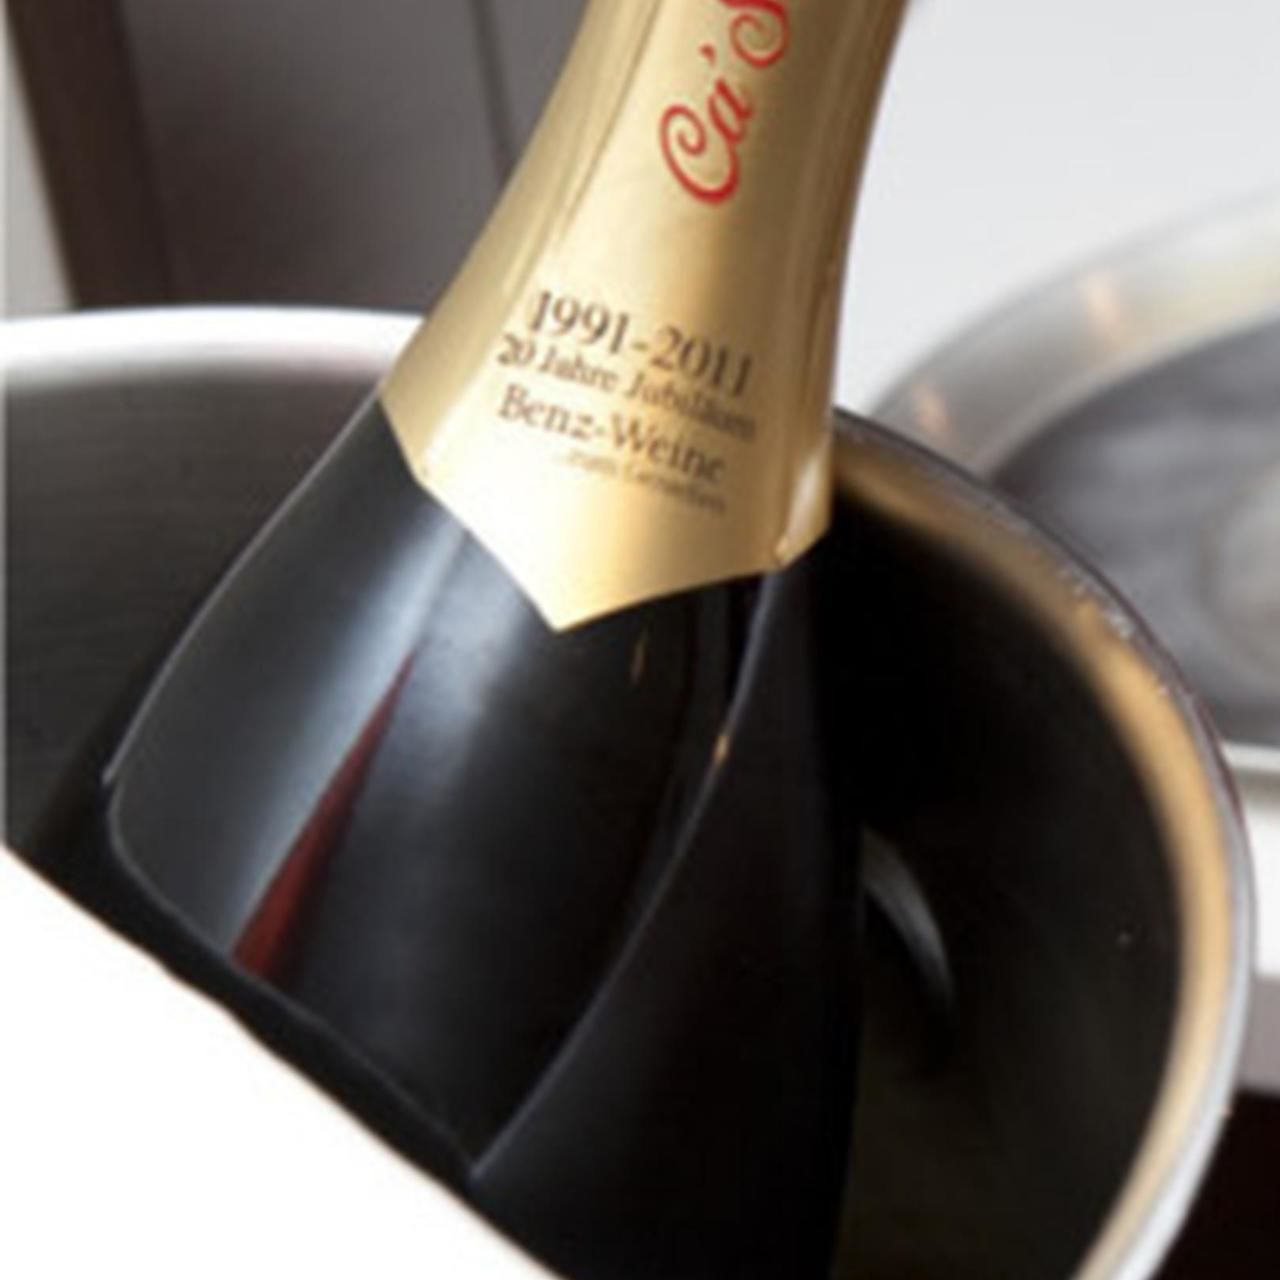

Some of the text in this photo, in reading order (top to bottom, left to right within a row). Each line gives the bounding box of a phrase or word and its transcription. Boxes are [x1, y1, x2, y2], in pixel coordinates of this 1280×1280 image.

[497, 333, 537, 366] 20
[538, 345, 620, 392] Jahre
[526, 290, 754, 398] 1991-2011
[498, 382, 728, 484] Benz-Weine
